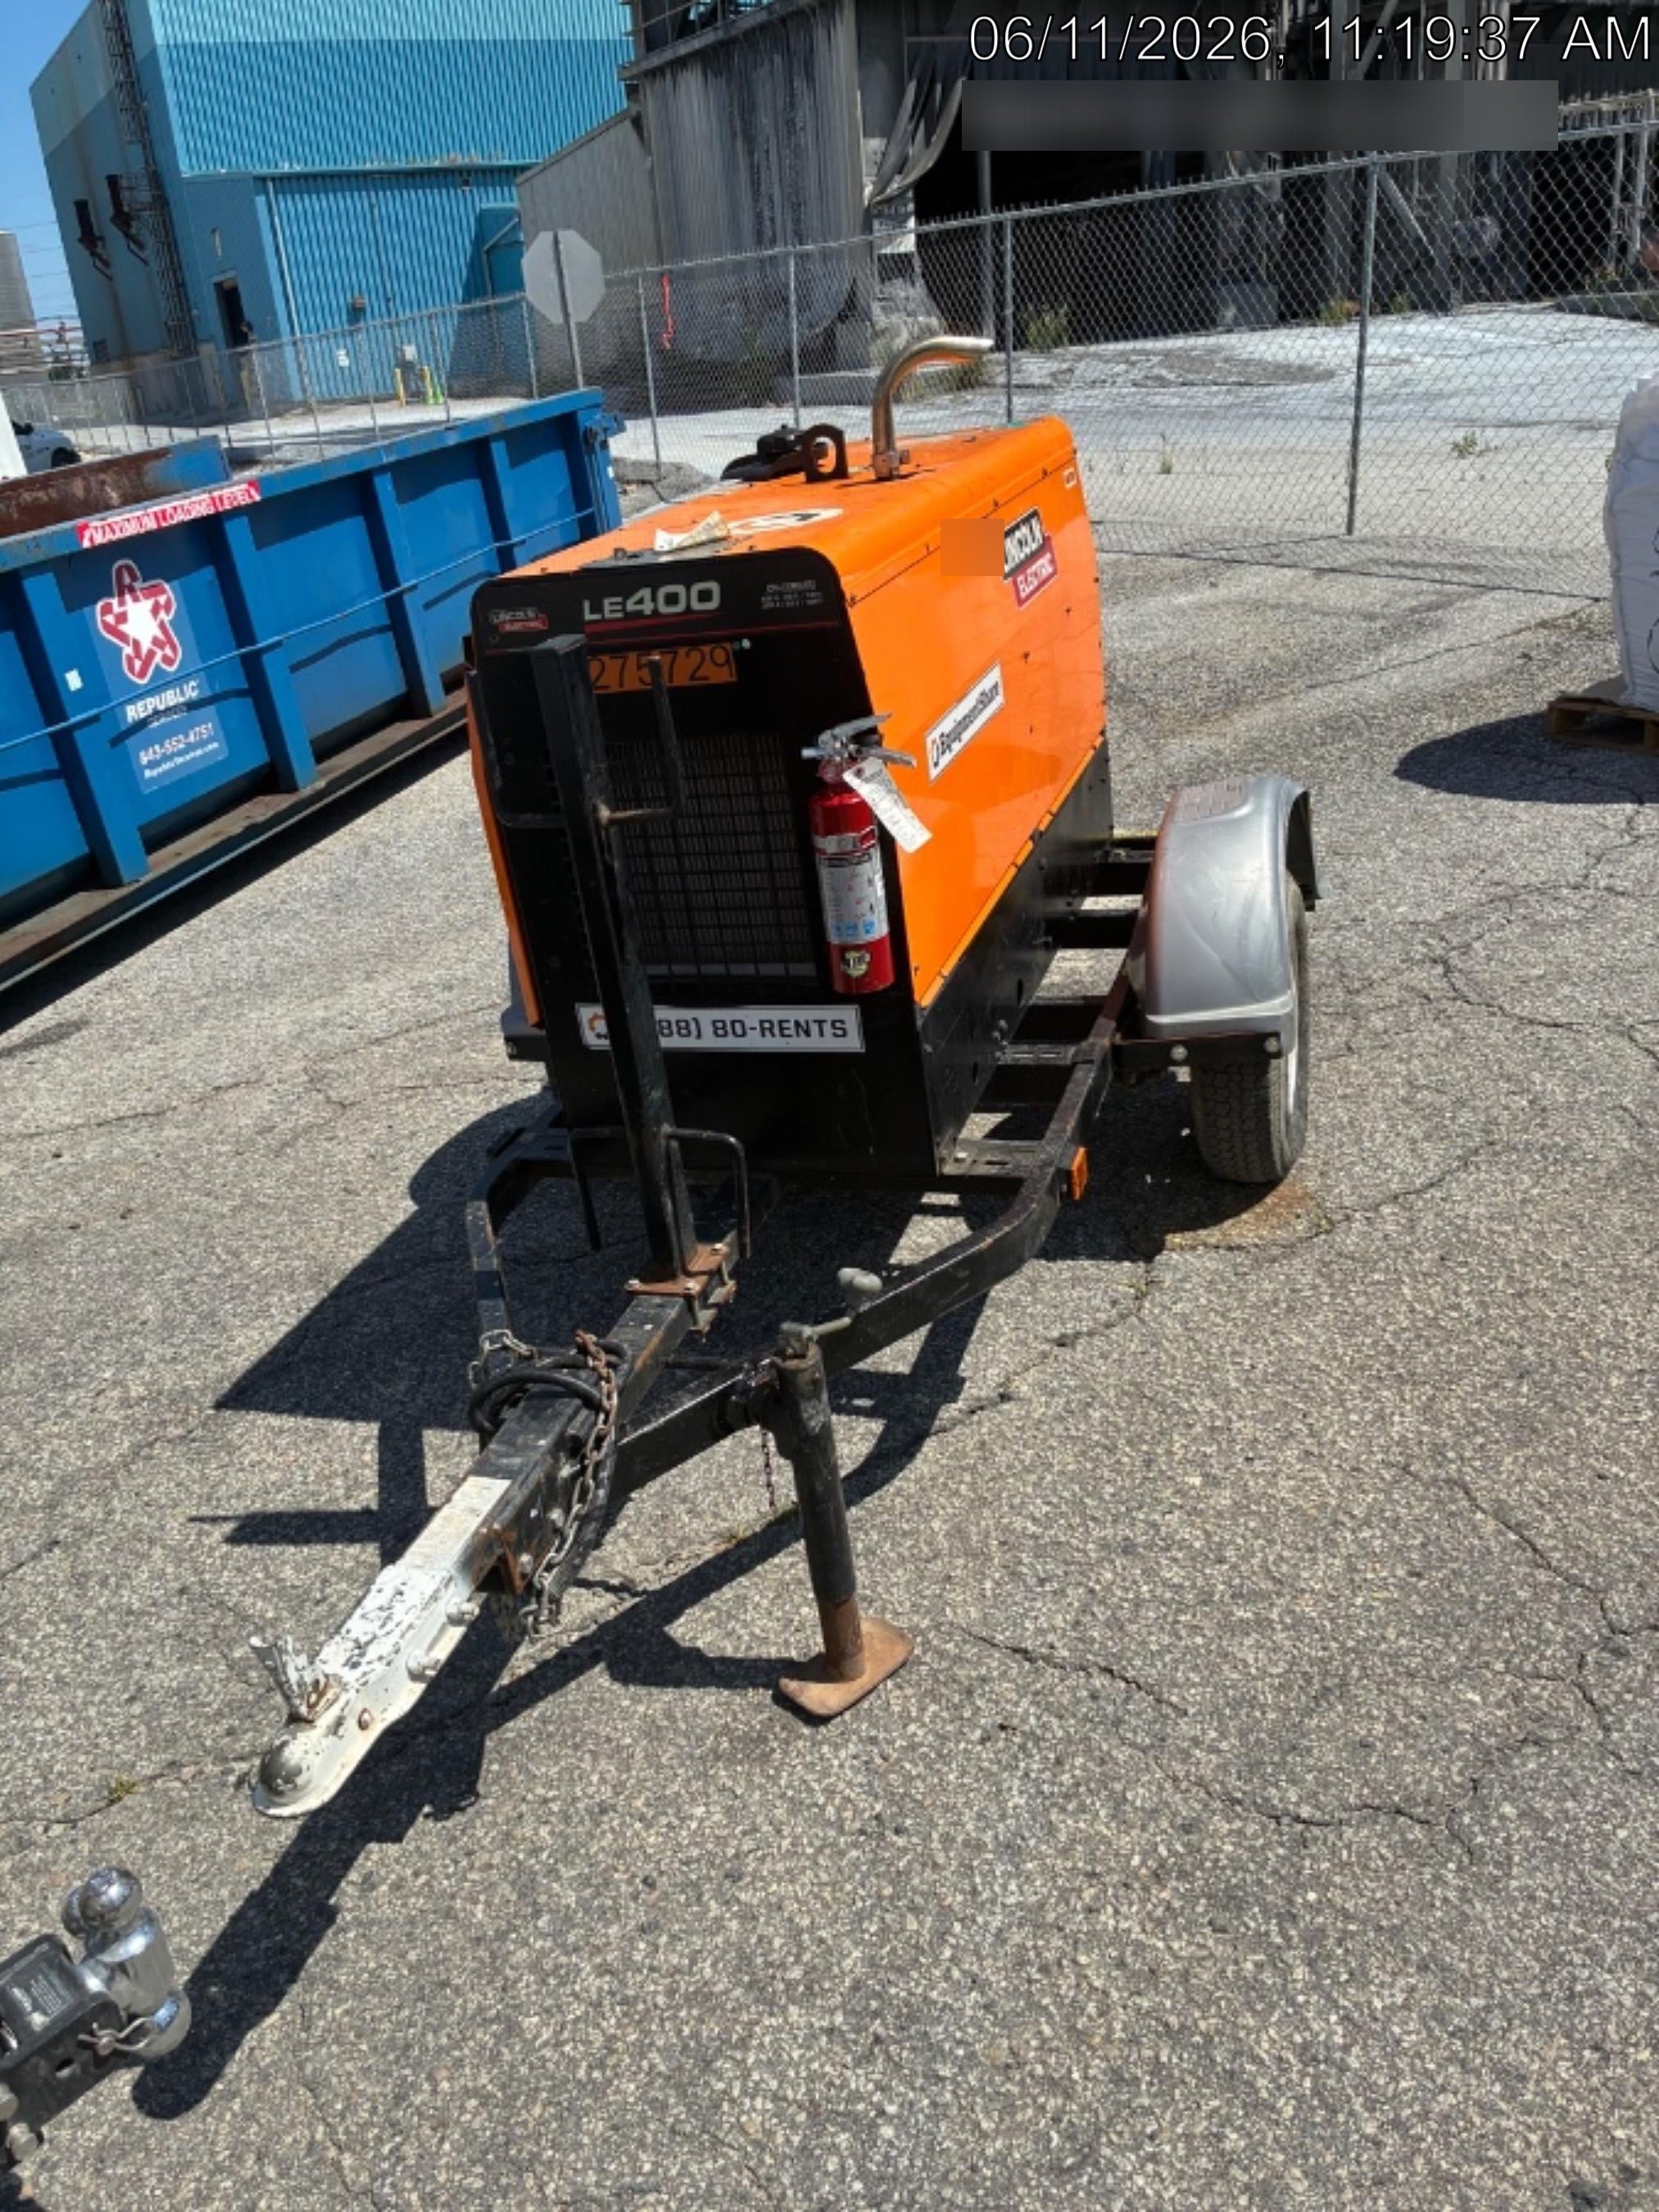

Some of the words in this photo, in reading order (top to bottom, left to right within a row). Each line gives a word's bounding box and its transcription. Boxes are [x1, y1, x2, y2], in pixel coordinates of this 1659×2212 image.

[91, 511, 157, 546] MAXIMUM
[582, 580, 721, 621] LE400
[589, 645, 734, 691] 275729
[126, 680, 199, 723] REPUBLIC
[712, 1018, 849, 1039] 80-RENTS
